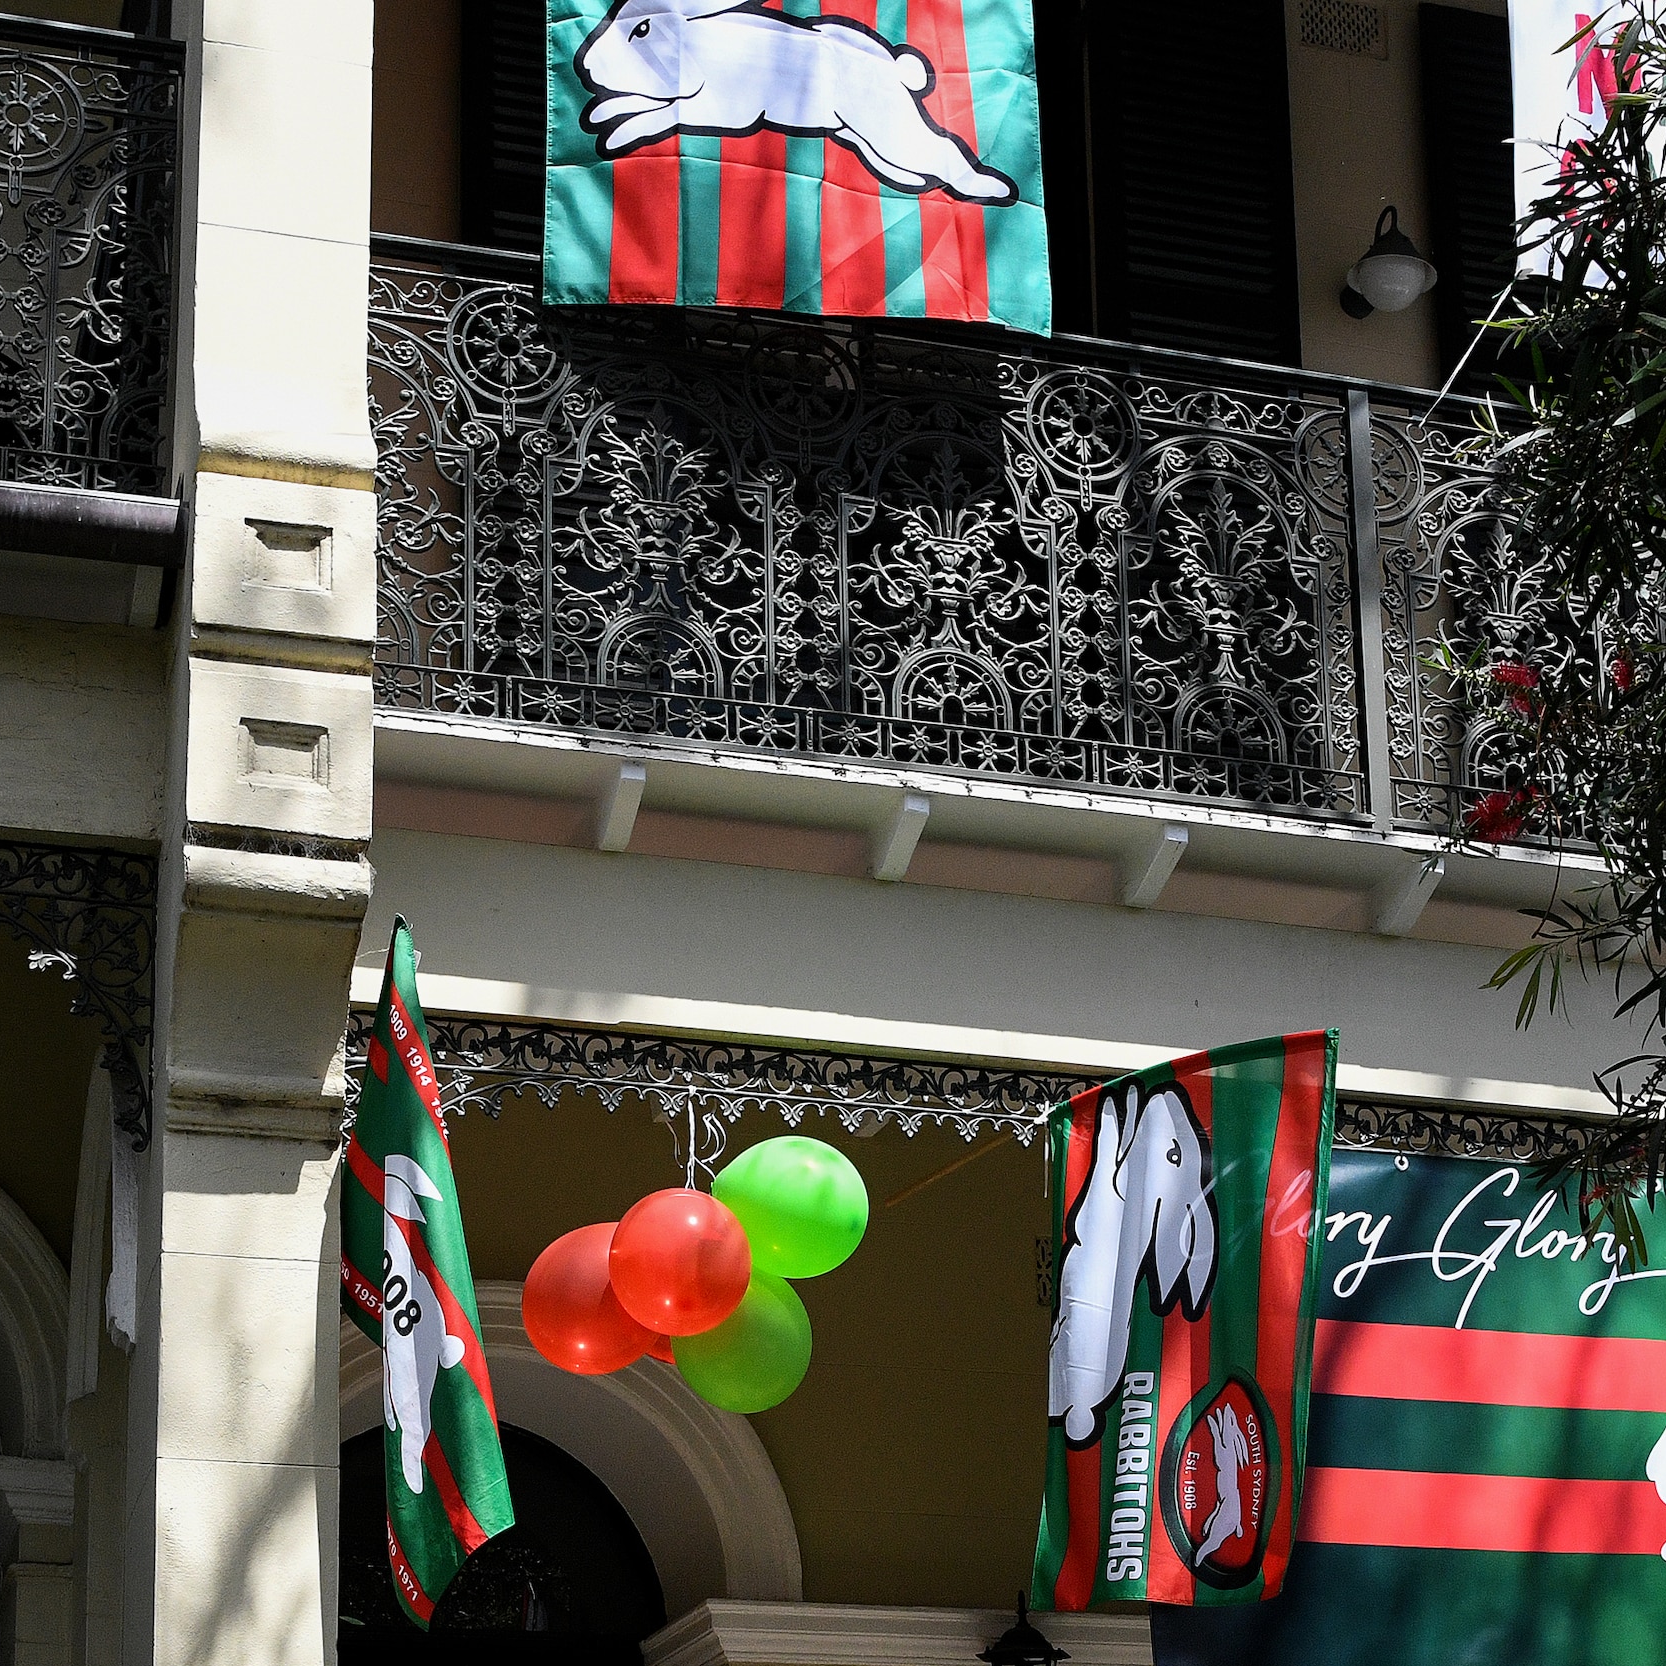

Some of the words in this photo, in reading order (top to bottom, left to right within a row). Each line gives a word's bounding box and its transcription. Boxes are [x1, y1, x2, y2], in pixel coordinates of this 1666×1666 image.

[389, 1004, 408, 1041] 1909
[405, 1046, 433, 1087] 1914
[354, 1282, 383, 1314] 1951
[1183, 1450, 1200, 1475] Est.
[1244, 1412, 1263, 1465] SOUTH
[1106, 1371, 1155, 1582] RABBITOHS
[1183, 1479, 1198, 1511] 1908
[1251, 1467, 1263, 1530] SYDNEY
